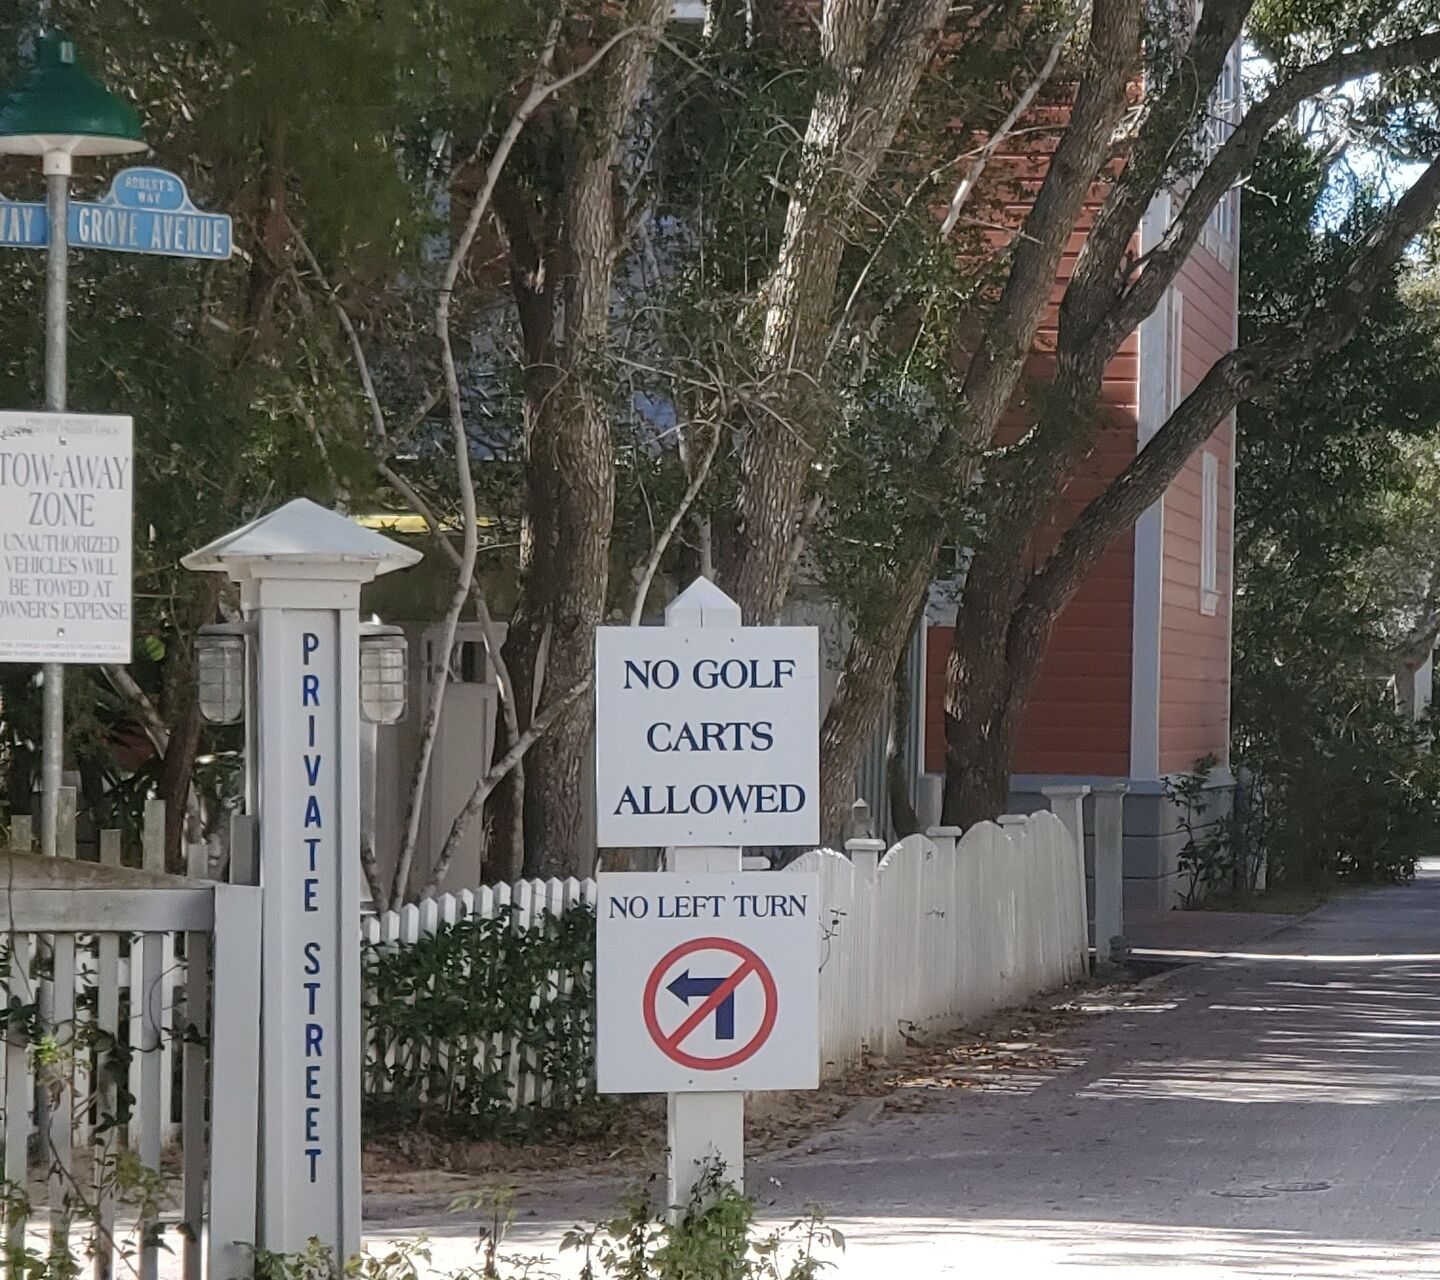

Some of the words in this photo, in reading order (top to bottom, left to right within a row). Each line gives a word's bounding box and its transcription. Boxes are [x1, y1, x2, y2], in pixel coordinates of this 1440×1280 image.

[137, 190, 161, 204] WAY
[79, 207, 139, 247] GROVE
[151, 216, 224, 254] AVENUE
[0, 452, 129, 490] TOW-AWAY
[28, 491, 96, 527] ZONE
[3, 533, 119, 554] UNAUTHORIZED
[4, 555, 78, 575] VEHICLES
[81, 558, 119, 576] WILL
[9, 578, 29, 596] BE
[32, 579, 89, 598] TOWED
[92, 580, 114, 598] AT
[63, 601, 129, 621] EXPENSE
[623, 659, 680, 690] NO
[692, 658, 797, 690] GOLF
[646, 721, 774, 753] CARTS
[302, 632, 322, 913] PRIVATE
[612, 783, 806, 816] ALLOWED
[608, 895, 649, 920] NO
[657, 895, 726, 919] LEFT
[733, 894, 809, 918] TURN
[303, 941, 324, 1183] STREET
